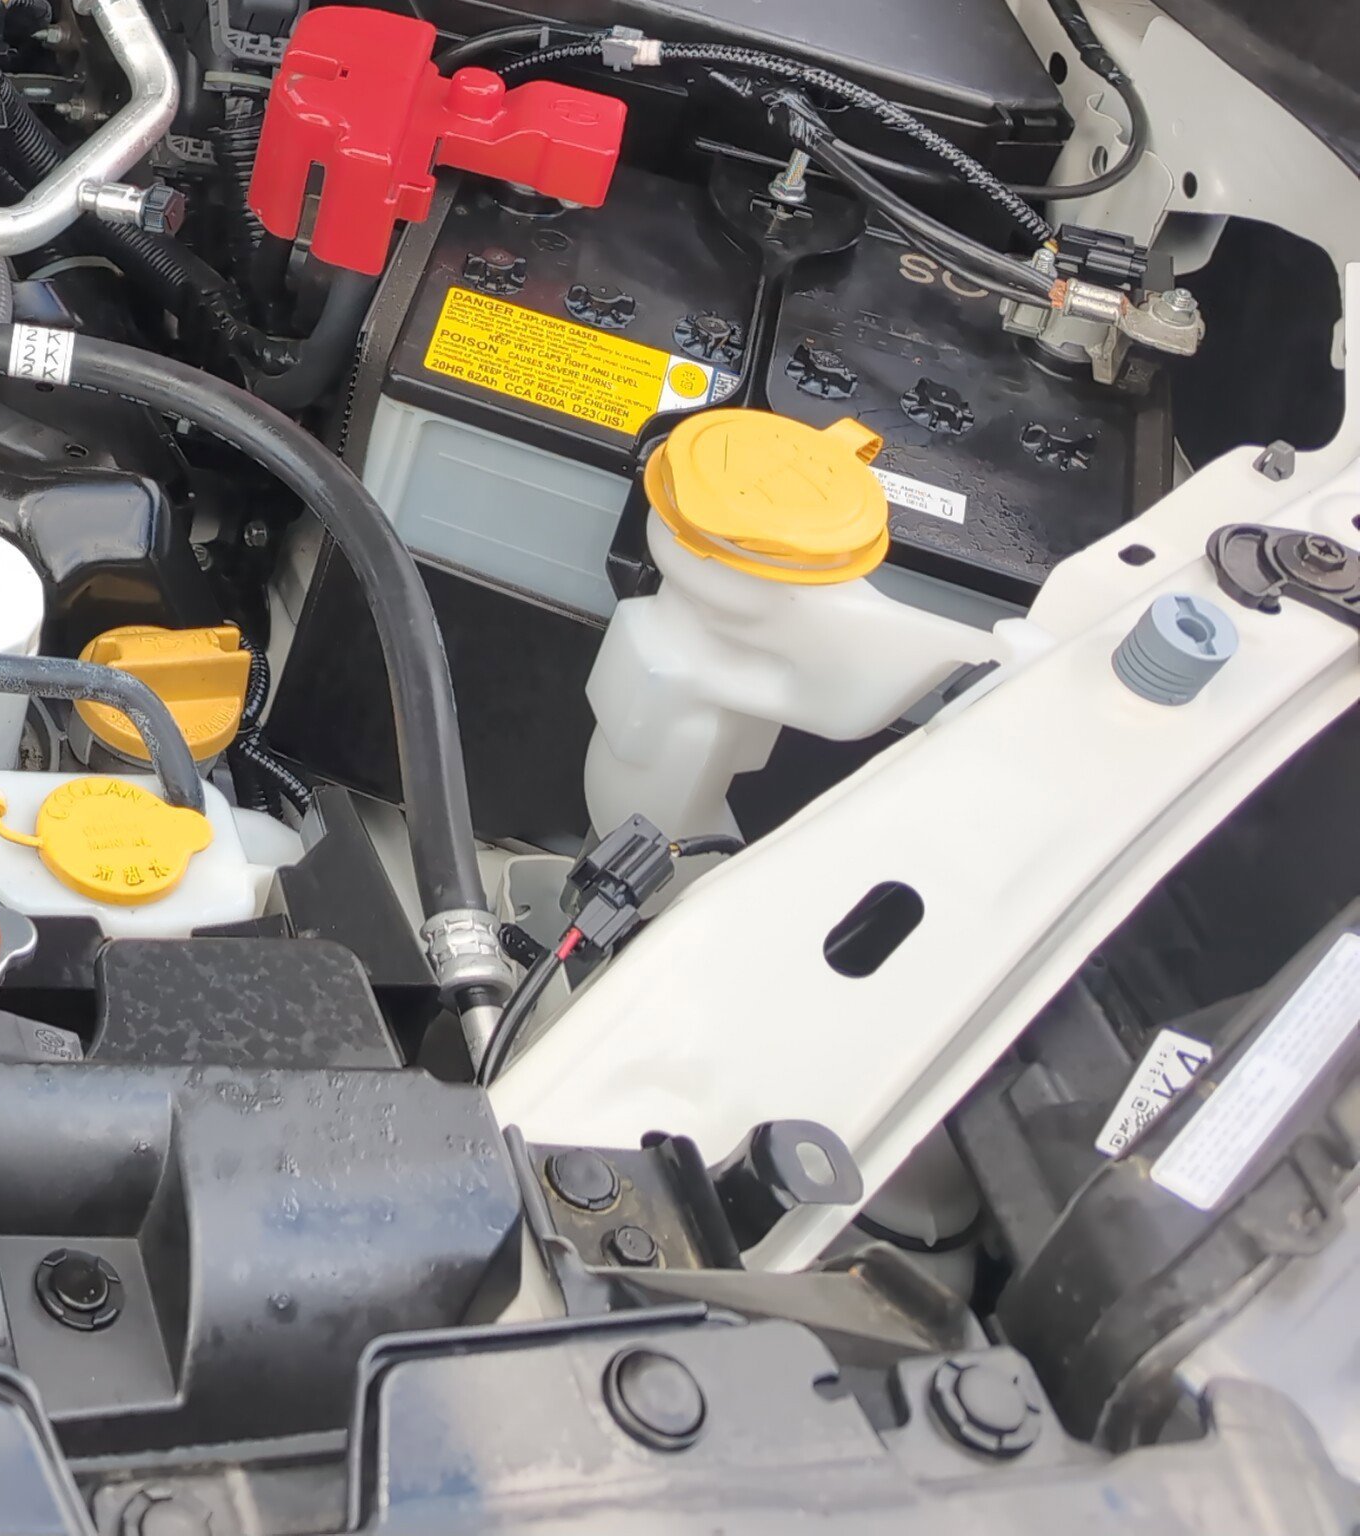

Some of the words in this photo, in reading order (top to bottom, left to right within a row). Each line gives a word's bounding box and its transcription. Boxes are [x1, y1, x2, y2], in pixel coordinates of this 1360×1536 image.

[452, 290, 514, 316] DANGER
[439, 328, 499, 354] POISON
[507, 350, 543, 367] CAUSES
[544, 362, 580, 379] SEVERE
[513, 342, 535, 354] VENT
[610, 373, 639, 387] LEVEL
[430, 358, 463, 376] 20HR
[466, 369, 498, 387] 62Ah
[503, 381, 533, 398] CCA
[571, 404, 625, 428] D23(JIS)
[502, 371, 521, 382] OUT
[536, 382, 568, 398] REACH
[569, 392, 582, 402] OF
[583, 397, 629, 418] CHILDREN
